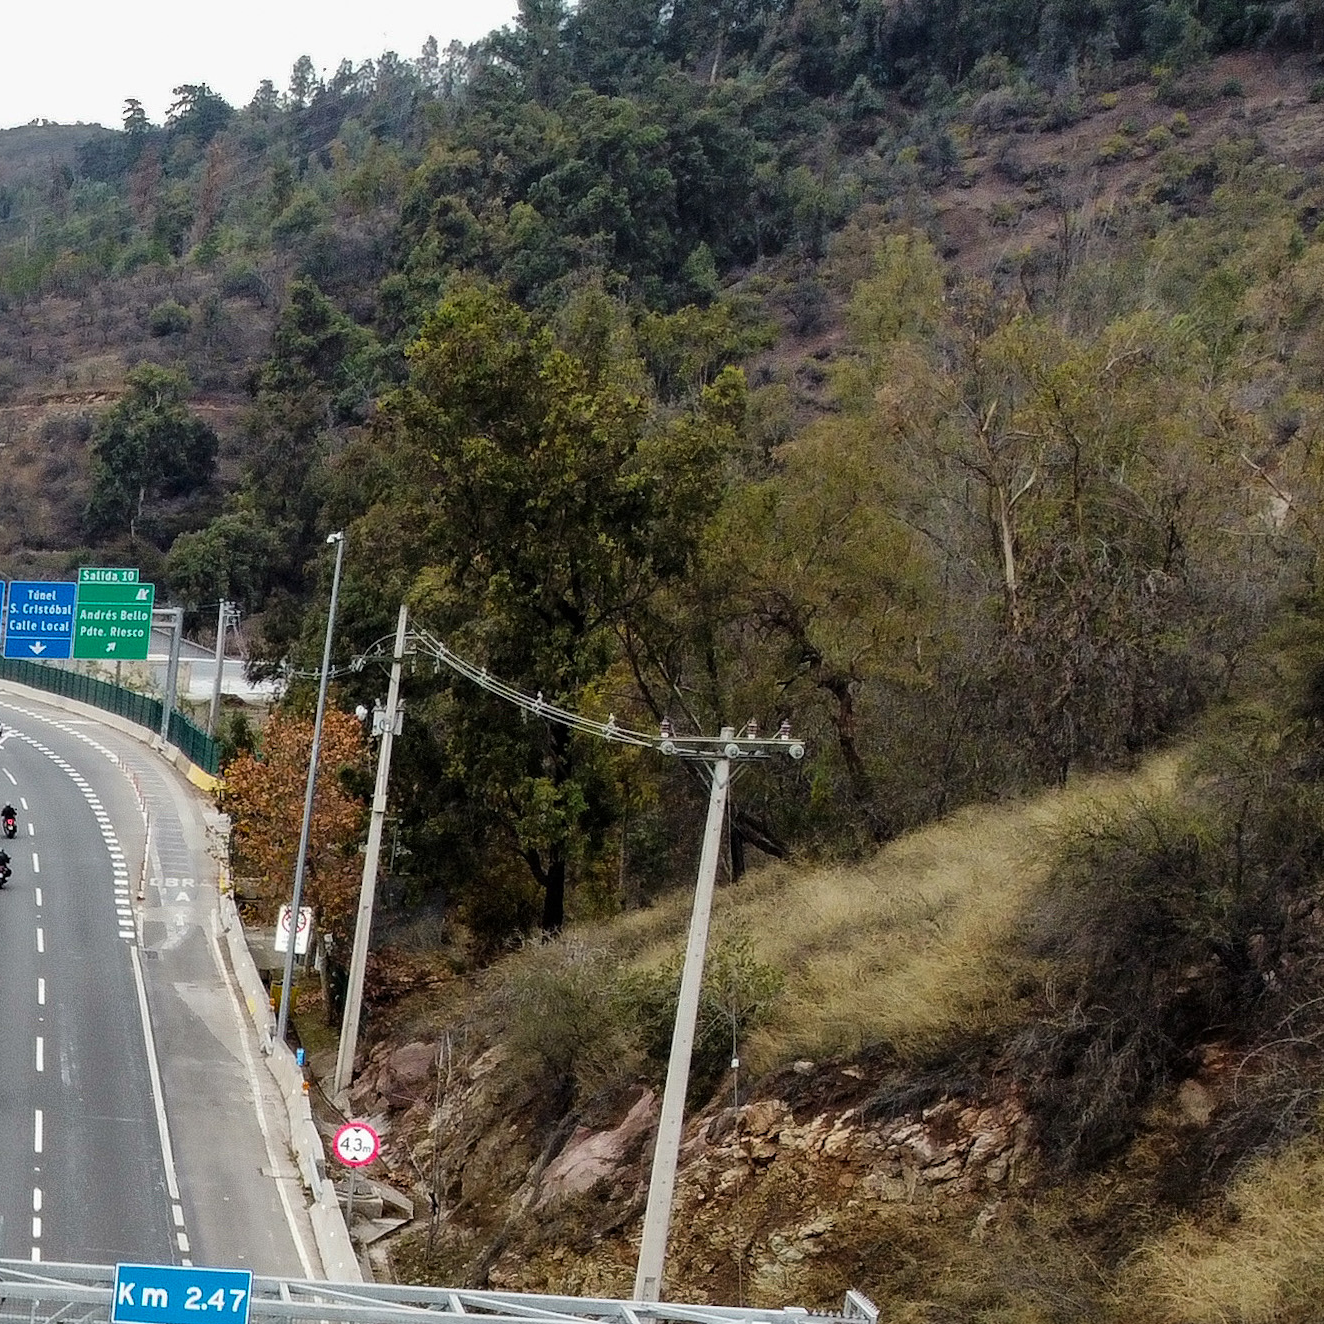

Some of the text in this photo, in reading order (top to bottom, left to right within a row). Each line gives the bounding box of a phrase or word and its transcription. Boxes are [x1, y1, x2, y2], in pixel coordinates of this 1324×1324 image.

[83, 570, 135, 581] Salida 10
[28, 589, 57, 601] Túnel
[9, 602, 72, 615] S. Cristóbal
[79, 609, 149, 621] Andrés Bello
[9, 619, 70, 632] Calle Local
[79, 625, 145, 638] Pdte. Riesco
[118, 1281, 246, 1313] Km 2.47
